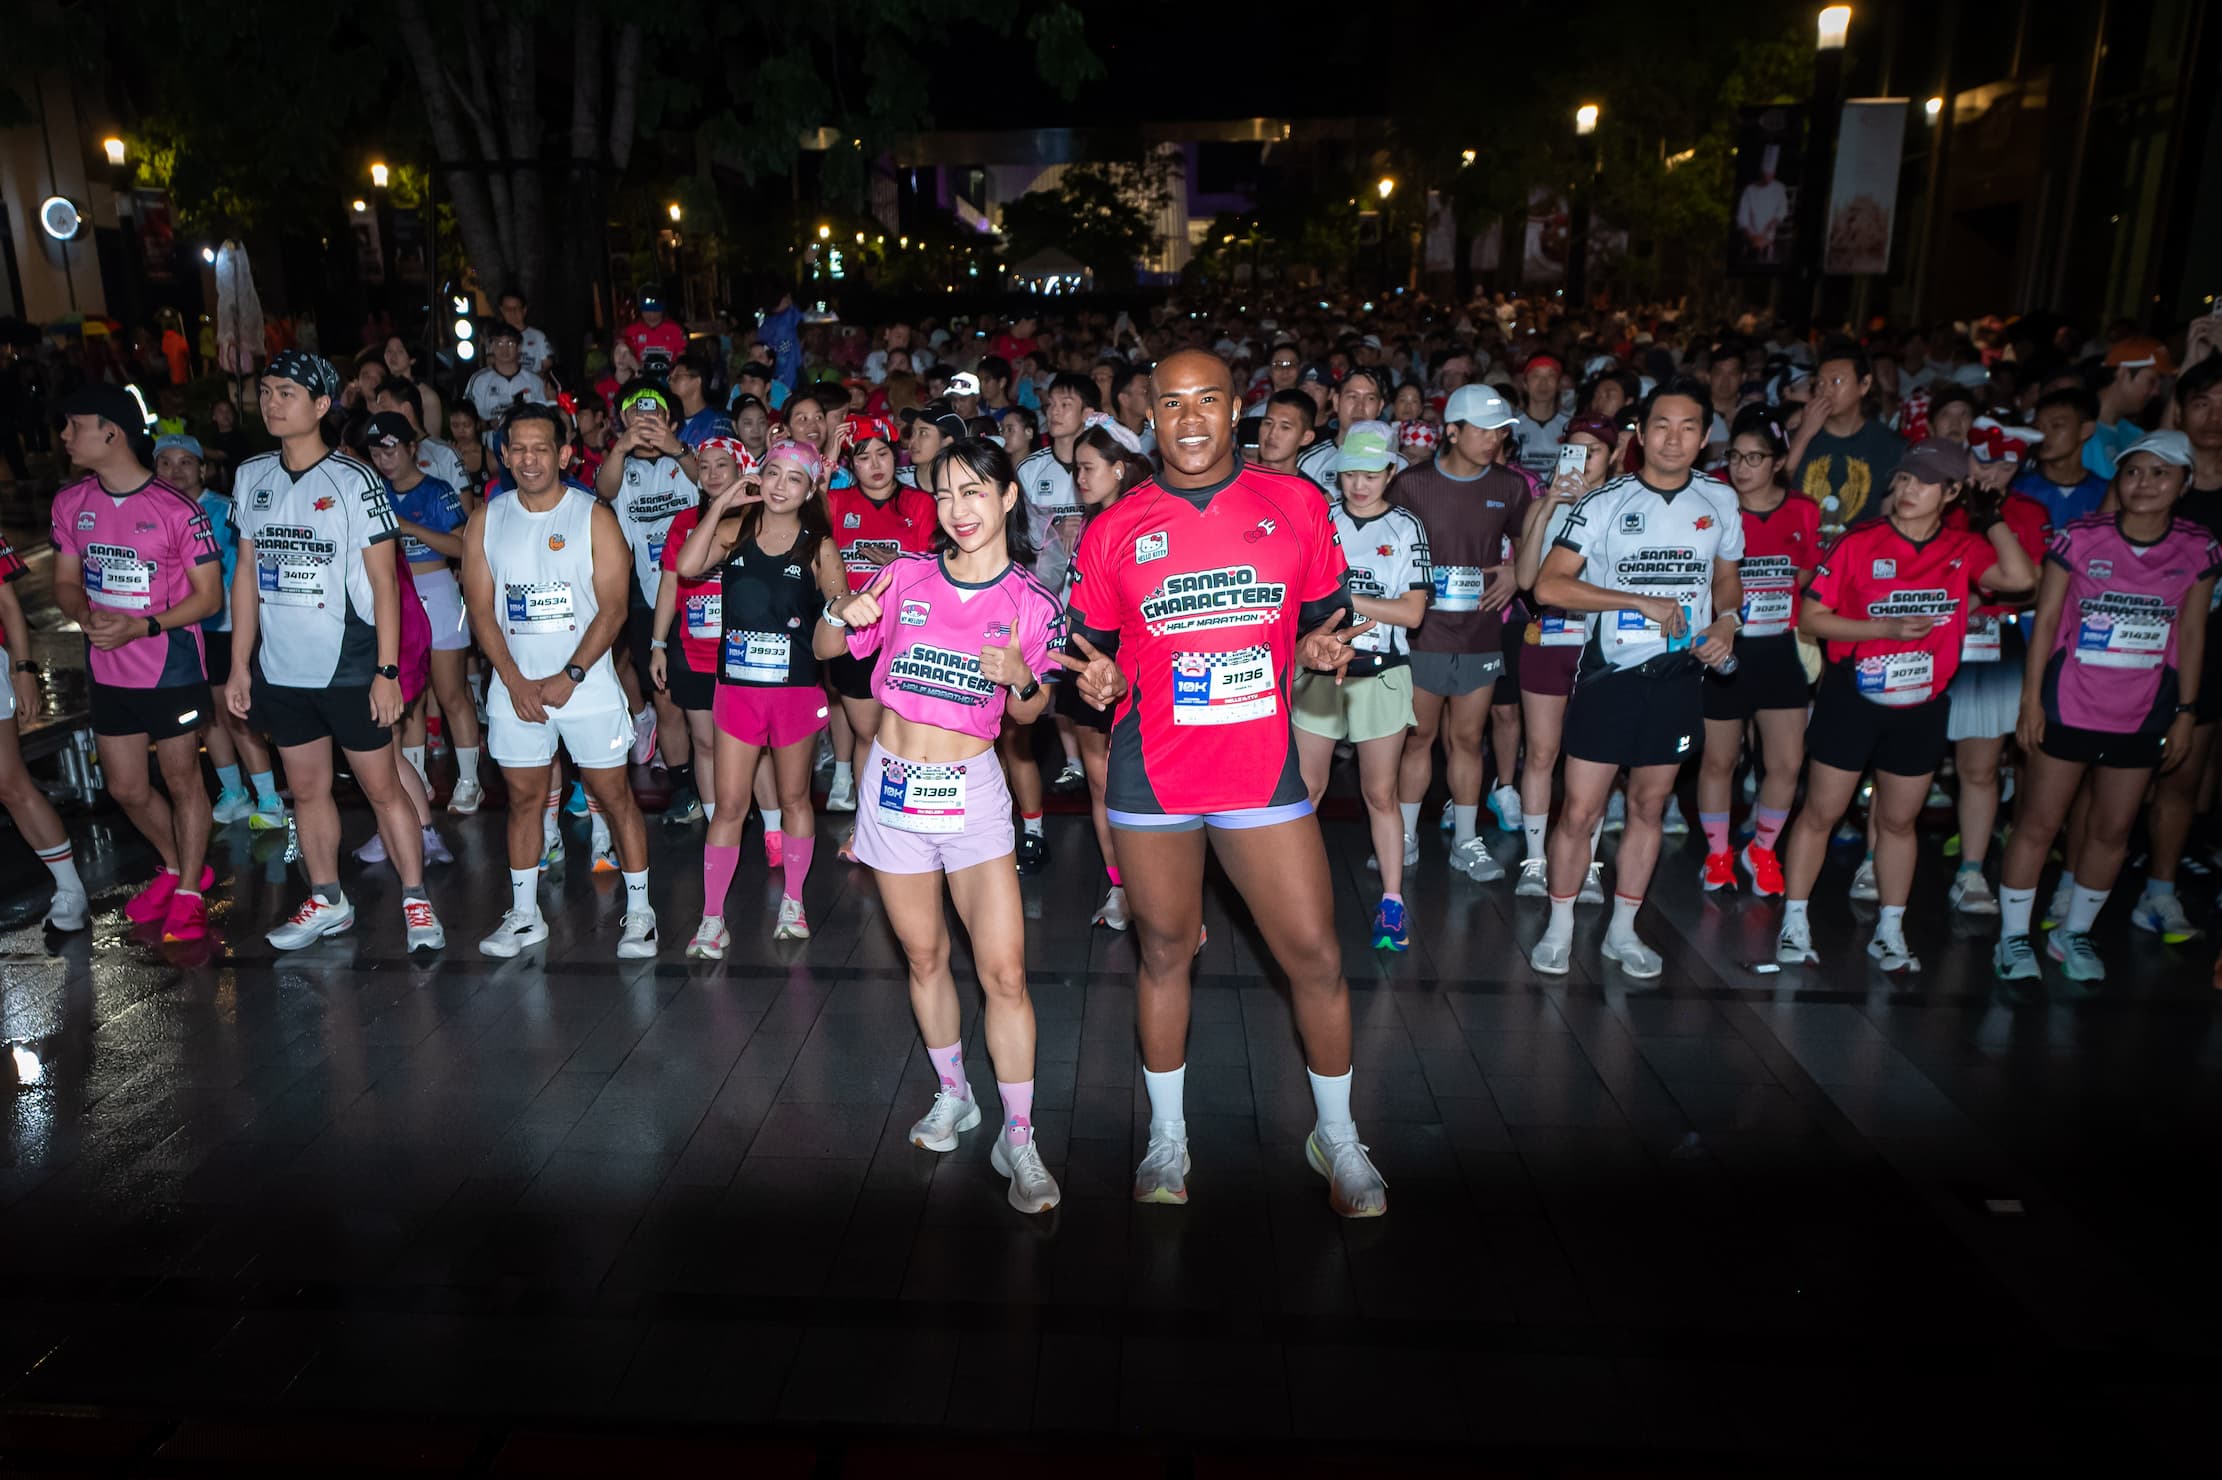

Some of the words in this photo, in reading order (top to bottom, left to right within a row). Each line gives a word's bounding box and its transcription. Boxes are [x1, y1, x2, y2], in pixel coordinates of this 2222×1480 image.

[283, 570, 316, 580] 34107
[1167, 569, 1253, 595] SANRIO
[529, 597, 567, 607] 34534
[1143, 587, 1283, 619] CHARACTERS
[1166, 620, 1195, 631] HALF
[1196, 614, 1258, 627] MARATHON
[1222, 668, 1263, 685] 31136
[1891, 666, 1929, 678] 30725
[902, 682, 927, 693] HALF
[1177, 681, 1208, 693] 10K
[883, 785, 905, 800] 10K
[912, 787, 957, 797] 31389
